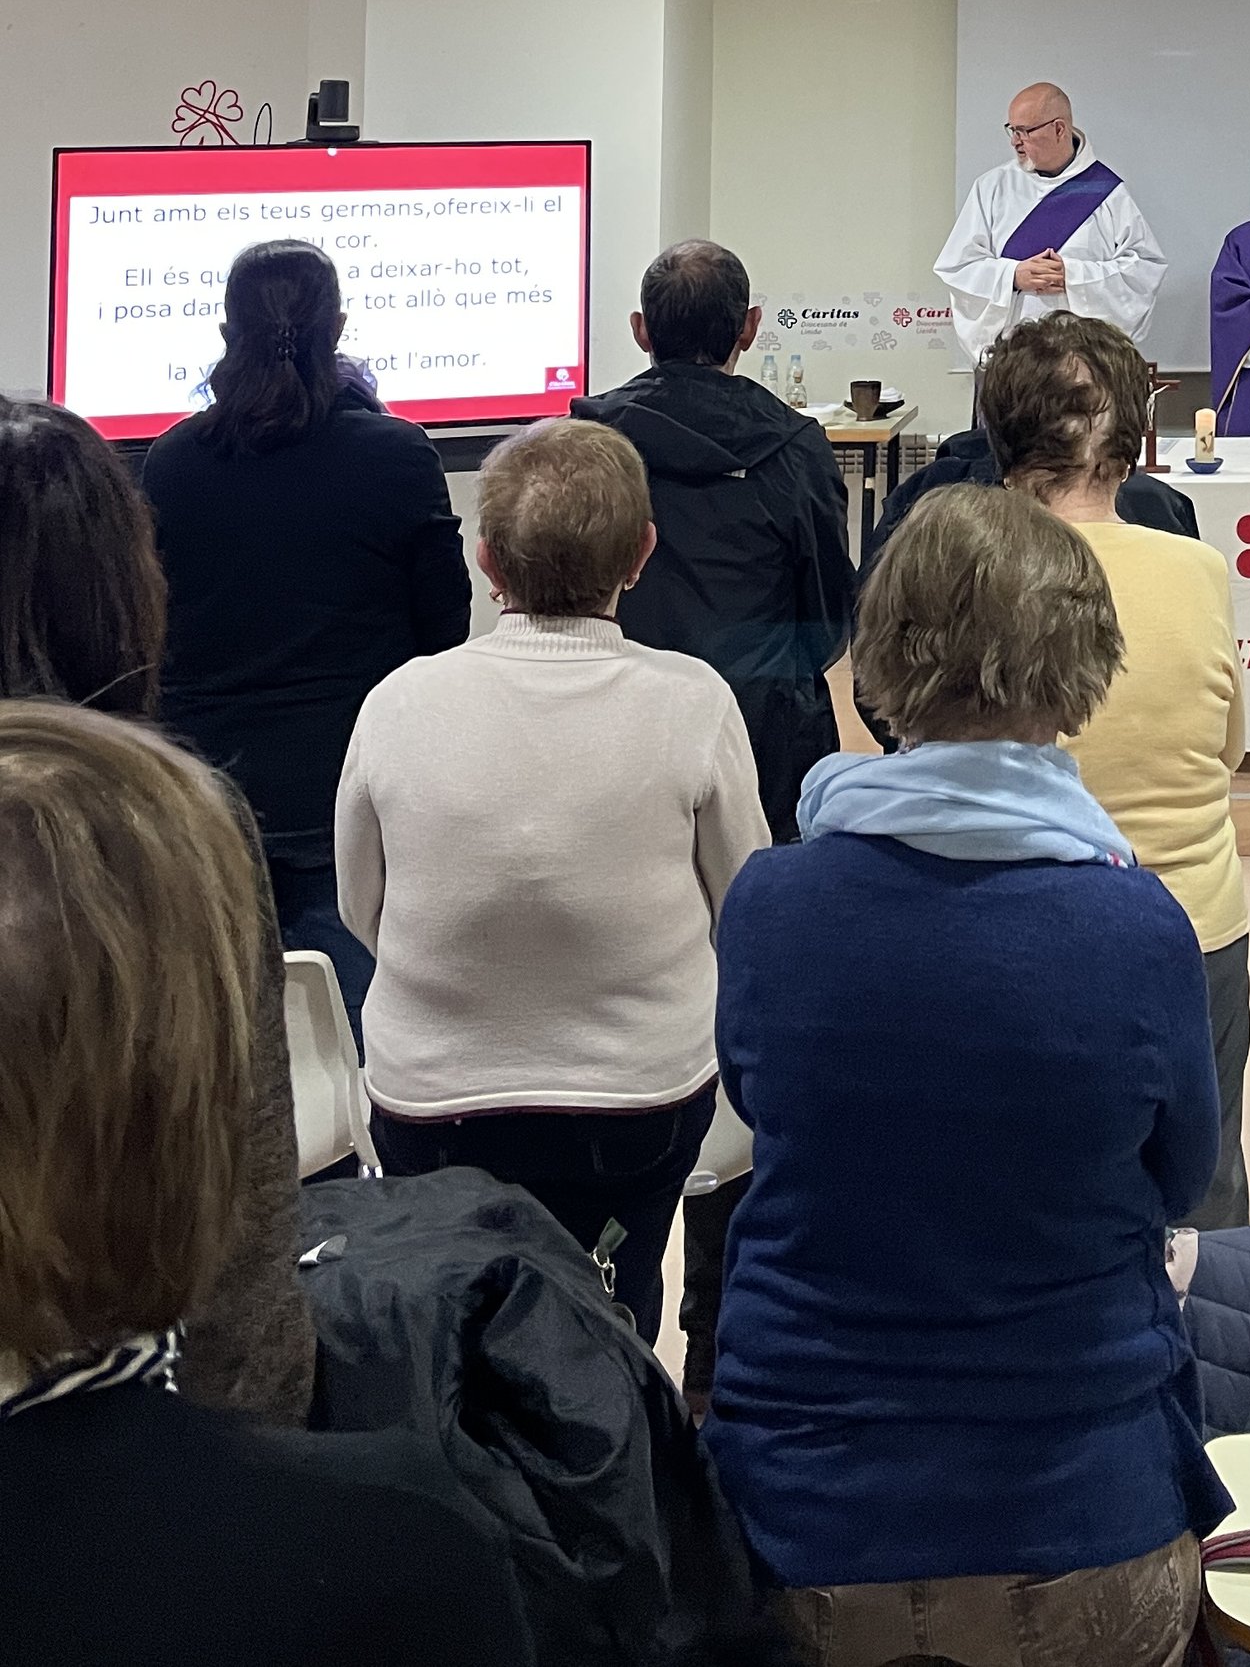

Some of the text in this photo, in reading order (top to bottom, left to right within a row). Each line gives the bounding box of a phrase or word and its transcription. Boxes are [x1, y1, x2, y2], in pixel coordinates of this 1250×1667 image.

[89, 205, 143, 224] Junt
[153, 204, 206, 222] amb
[217, 203, 250, 221] els
[261, 203, 311, 220] teus
[544, 195, 562, 213] el
[335, 234, 378, 249] cor.
[125, 257, 529, 288] Ell és qu a deixar-ho tot,
[98, 302, 103, 319] i
[114, 303, 172, 323] posa
[365, 293, 397, 310] tot
[406, 288, 446, 308] allò
[455, 291, 497, 310] que
[507, 284, 552, 304] més
[801, 308, 859, 319] Càritas
[916, 307, 953, 318] Càri
[168, 363, 187, 381] la
[366, 354, 398, 371] tot
[407, 351, 487, 369] l'amor.
